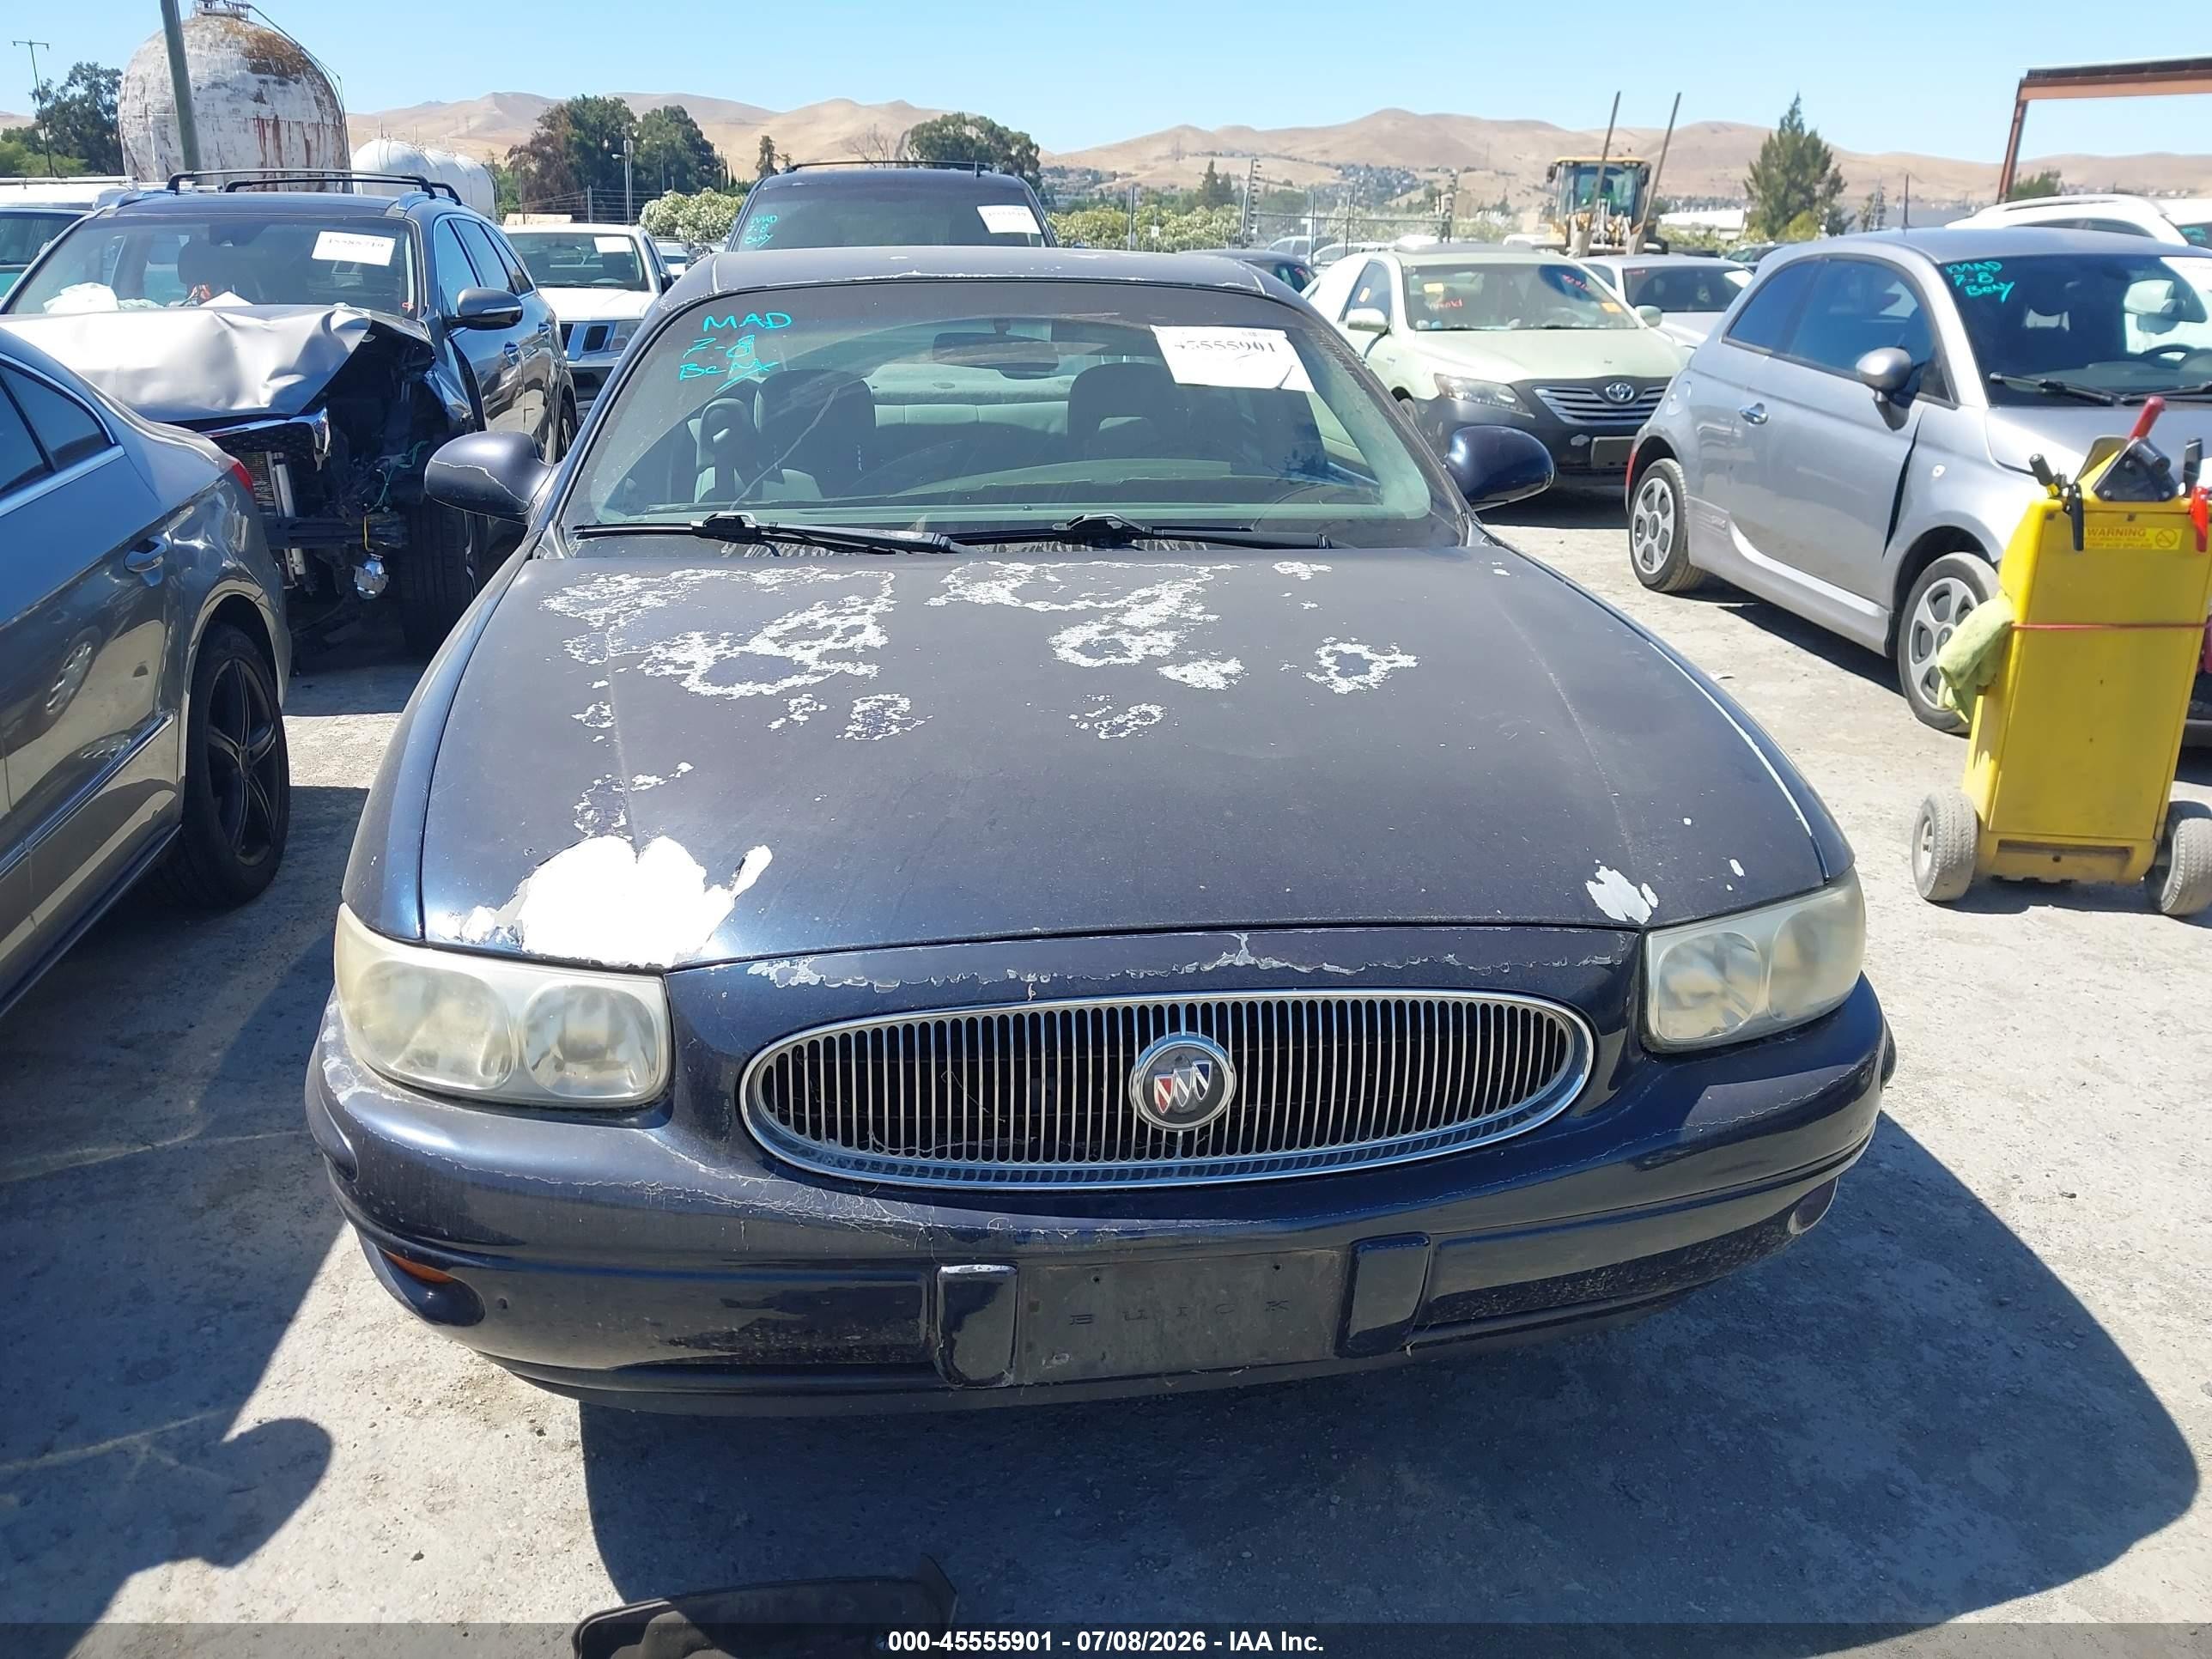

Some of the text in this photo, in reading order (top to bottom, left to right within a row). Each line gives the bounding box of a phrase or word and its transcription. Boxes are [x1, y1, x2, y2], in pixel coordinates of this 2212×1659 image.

[1945, 260, 2002, 274] MAD
[702, 311, 793, 332] MAD
[2087, 528, 2146, 537] WARNING
[1069, 1299, 1290, 1327] BUICK
